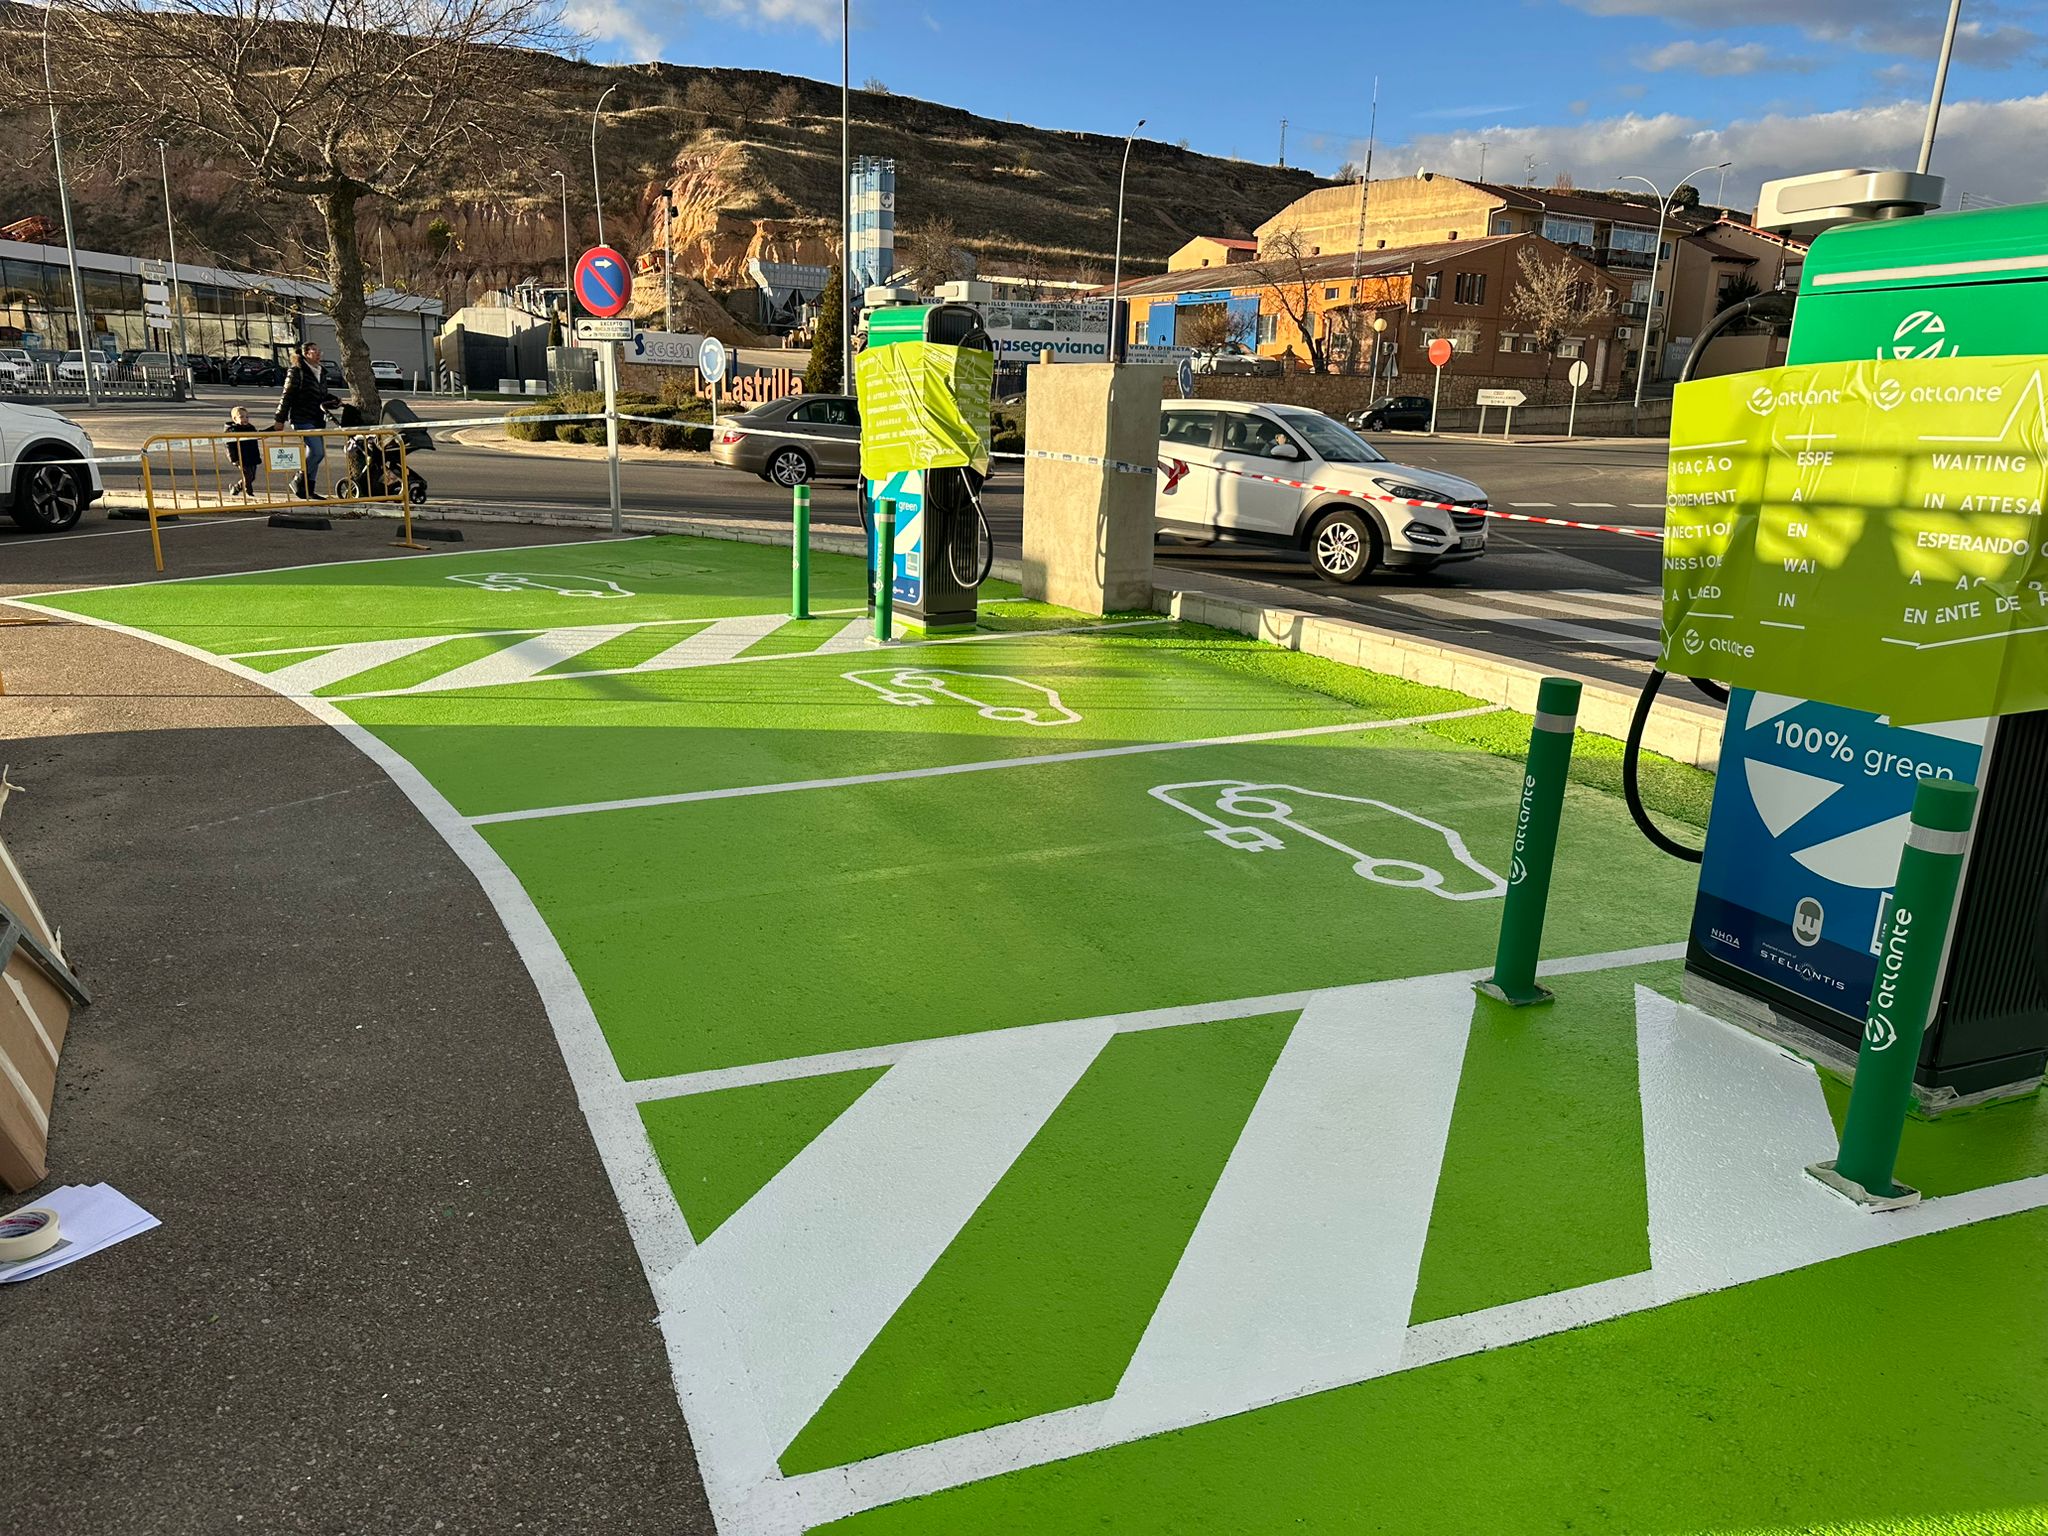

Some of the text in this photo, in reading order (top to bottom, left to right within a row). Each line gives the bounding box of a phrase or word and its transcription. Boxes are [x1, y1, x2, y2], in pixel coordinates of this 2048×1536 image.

[634, 333, 694, 359] SEGESA
[721, 367, 803, 403] Lastrilla
[1910, 385, 2003, 403] atlante
[1931, 453, 2027, 474] WAITING
[898, 501, 918, 512] green
[1791, 487, 1803, 502] A
[1923, 492, 2043, 516] IN ATTESA
[1787, 522, 1808, 538] EN
[1916, 531, 2030, 556] ESPERANDO
[1783, 557, 1816, 574] WAI
[1909, 569, 1922, 586] A
[1777, 592, 1796, 608] IN
[1903, 607, 1928, 625] EN
[1995, 595, 2021, 613] DE
[1773, 719, 1954, 781] 100% green
[1514, 774, 1536, 852] atlante
[1760, 949, 1846, 991] STELLANTIS
[1877, 908, 1913, 1009] atlante
